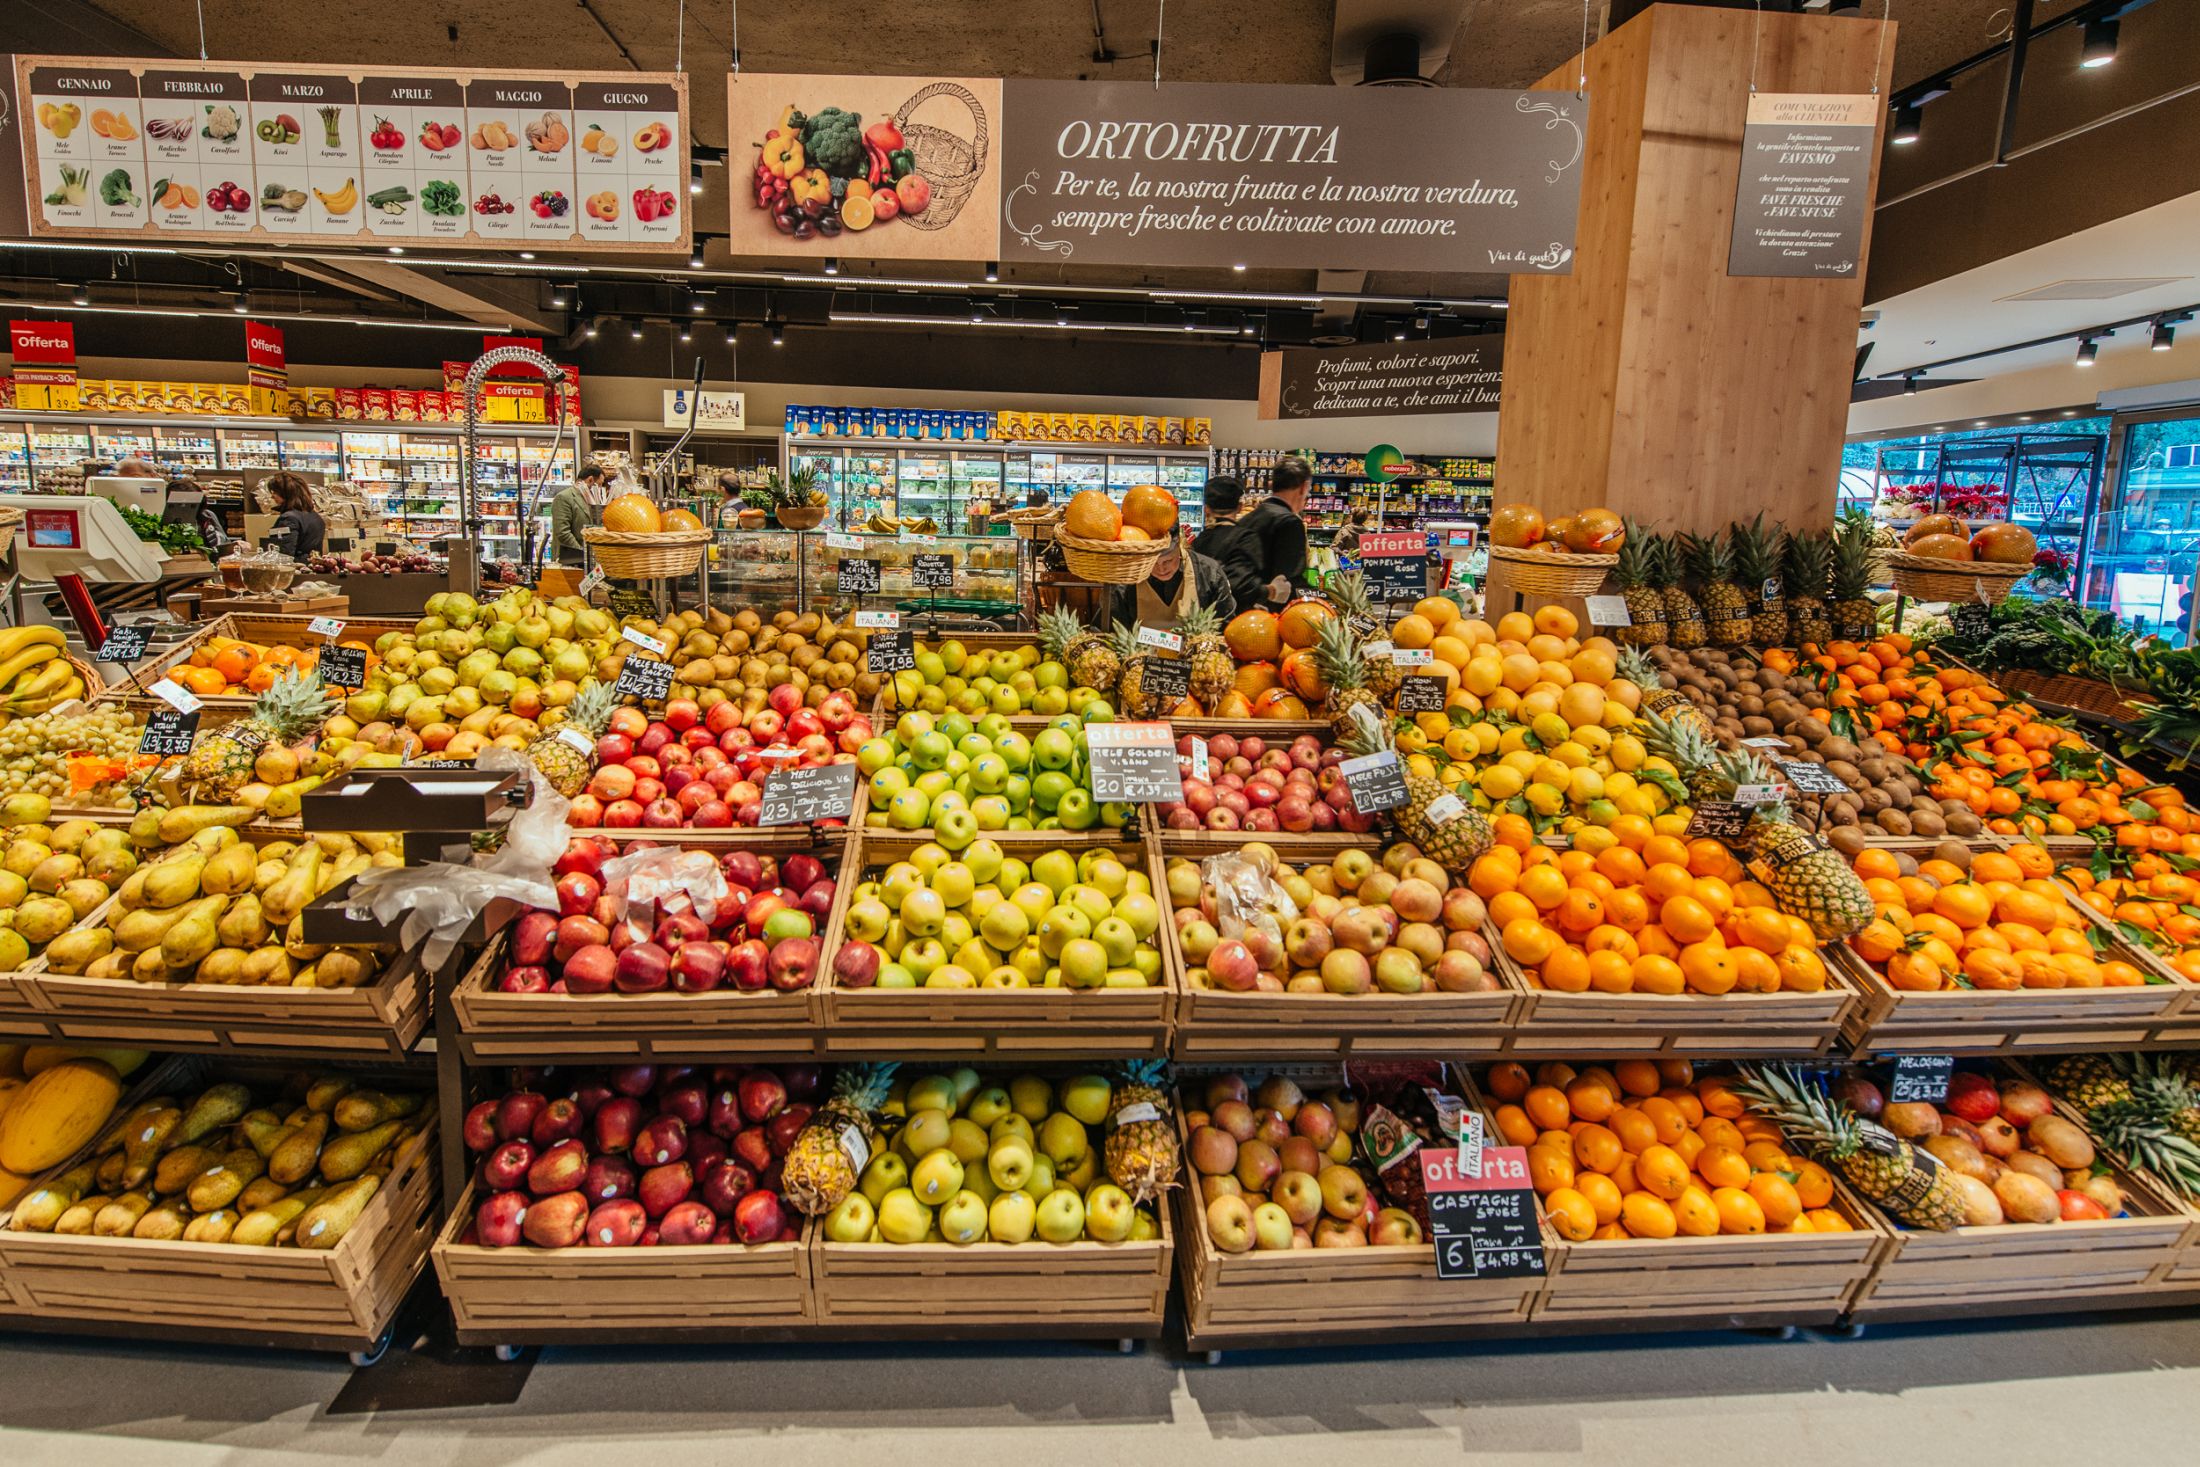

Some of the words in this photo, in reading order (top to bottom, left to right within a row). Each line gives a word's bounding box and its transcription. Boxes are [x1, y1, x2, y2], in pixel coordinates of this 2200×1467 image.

[57, 78, 111, 90] GENNAIO
[164, 81, 224, 94] FEBBRAIO
[282, 85, 324, 97] MARZO
[390, 88, 433, 100] APRILE
[495, 90, 542, 102] MAGGIO
[603, 93, 649, 105] GIUGNO
[1773, 103, 1855, 112] COMUNICAZIONE
[1776, 112, 1793, 121] alla
[1794, 112, 1848, 121] CLIENTELA
[1056, 120, 1340, 164] ORTOFRUTTA
[1787, 132, 1832, 143] Informiamo
[273, 148, 288, 156] Kiwi
[1757, 142, 1764, 150] la
[1764, 143, 1790, 152] gentile
[1790, 143, 1824, 151] clientela
[429, 152, 452, 161] Fragole
[538, 155, 557, 163] Meloni
[644, 157, 664, 165] Pesche
[1779, 152, 1836, 165] FAVISMO
[1759, 174, 1772, 182] che
[1771, 174, 1785, 183] nel
[1783, 176, 1813, 185] reparto
[1812, 175, 1850, 185] ortofrutta
[1052, 170, 1094, 197] Per
[1097, 176, 1121, 200] te,
[1127, 172, 1150, 198] la
[1155, 178, 1228, 200] nostra
[1223, 174, 1297, 207] frutta
[1301, 185, 1316, 201] e
[1318, 176, 1343, 202] la
[1346, 182, 1421, 203] nostra
[1424, 179, 1519, 209] verdura,
[1802, 185, 1831, 193] vendita
[1760, 194, 1790, 205] FAVE
[1790, 194, 1846, 206] FRESCHE
[57, 209, 82, 217] Finocchi
[110, 211, 135, 219] Broccoli
[223, 213, 238, 221] Mele
[1769, 206, 1800, 217] FAVE
[1799, 207, 1838, 218] SFUSE
[273, 216, 297, 224] Carciofi
[487, 221, 509, 229] Ciliegie
[530, 222, 547, 230] Frutti
[547, 222, 554, 230] di
[1051, 208, 1135, 236] sempre
[1128, 204, 1215, 236] fresche
[1218, 215, 1232, 231] e
[1236, 207, 1333, 234] coltivate
[1335, 216, 1376, 234] con
[1380, 217, 1457, 236] amore.
[590, 224, 620, 232] Albicocche
[643, 224, 668, 233] Peperoni
[1754, 228, 1762, 237] Vi
[1762, 229, 1801, 237] chiediamo
[1801, 229, 1811, 237] di
[1809, 231, 1842, 240] prestare
[1759, 238, 1767, 246] la
[1768, 237, 1794, 247] dovuta
[1794, 239, 1834, 247] attenzione
[1488, 248, 1511, 264] Vivi
[1514, 250, 1526, 262] di
[1529, 249, 1559, 264] gusto
[1782, 248, 1808, 257] Grazie
[18, 336, 69, 349] Offerta
[251, 337, 282, 355] Offerta
[1316, 356, 1372, 378] Profumi,
[1376, 353, 1416, 372] colori
[1418, 355, 1427, 367] e
[1428, 348, 1480, 371] sapori.
[495, 386, 534, 396] offerta
[1314, 375, 1359, 396] Scopri
[1359, 377, 1386, 389] una
[1387, 374, 1433, 388] nuova
[44, 385, 52, 409] 1
[269, 390, 277, 413] 2
[1313, 394, 1370, 411] dedicata
[1371, 398, 1383, 408] a
[1384, 394, 1400, 409] te,
[1403, 391, 1428, 407] che
[1429, 390, 1459, 406] ami
[1461, 387, 1476, 403] il
[513, 397, 521, 420] 1
[525, 411, 537, 420] 79
[1384, 464, 1411, 473] noberasco
[828, 538, 861, 549] ITALIANO
[1362, 538, 1424, 552] offerta
[840, 576, 851, 589] 33
[857, 617, 897, 626] ITALIANO
[873, 641, 897, 650] SMITH
[1140, 633, 1179, 649] ITALIANO
[870, 655, 882, 668] 22
[1395, 656, 1432, 665] ITALIANO
[1400, 695, 1415, 708] 13
[162, 713, 181, 722] UVA
[154, 722, 177, 730] ITALIA
[1089, 726, 1169, 741] offerta
[144, 734, 158, 750] 43
[1092, 748, 1123, 758] MELE
[1127, 748, 1171, 758] GOLDEN
[790, 769, 817, 780] MELE
[1348, 772, 1373, 785] MELE
[1372, 765, 1400, 778] FUJI
[768, 782, 788, 792] RED
[791, 780, 832, 790] DELICIOUS
[1096, 779, 1119, 794] 20
[1736, 792, 1782, 801] ITALIANO
[765, 803, 789, 821] 23
[1898, 1056, 1954, 1069] MELOGRANO
[1468, 1116, 1481, 1173] ITALIANO
[1432, 1194, 1520, 1211] CASTAGNE
[1447, 1240, 1464, 1267] 6
